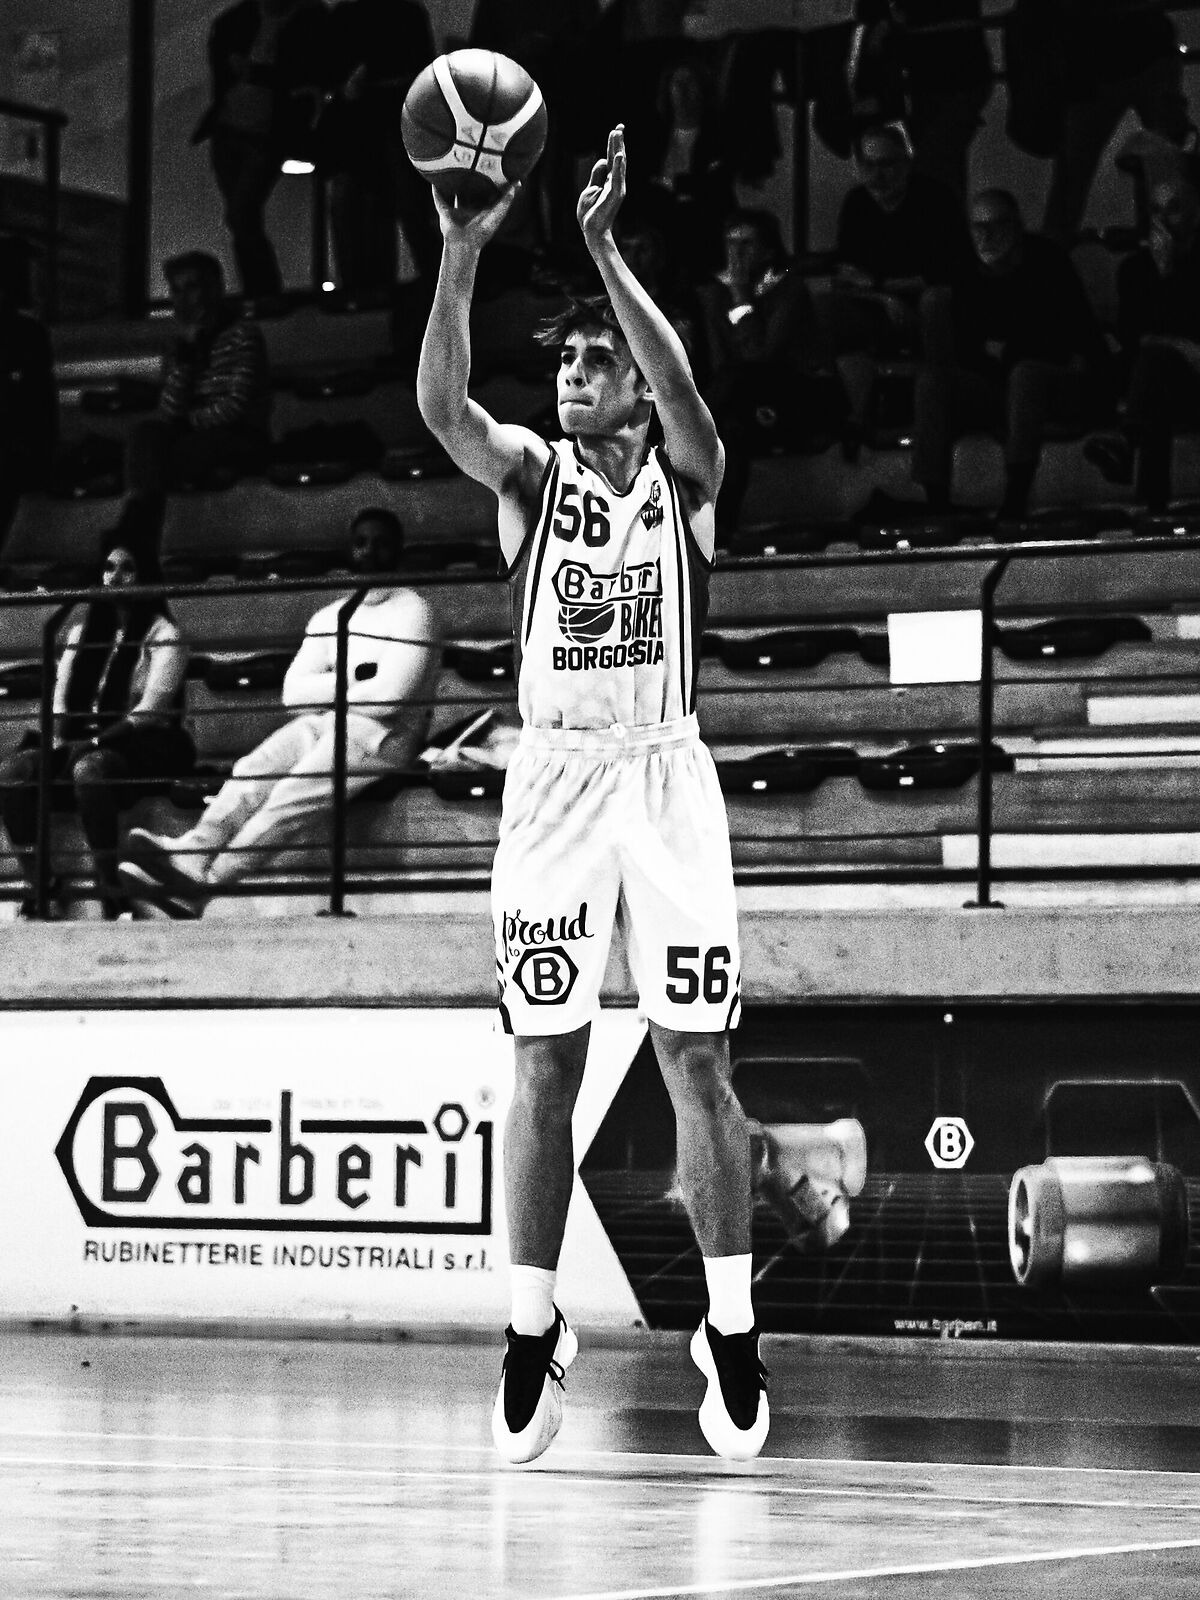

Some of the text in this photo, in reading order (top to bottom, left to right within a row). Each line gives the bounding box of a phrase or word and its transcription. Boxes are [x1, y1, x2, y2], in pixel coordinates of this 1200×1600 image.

[553, 482, 611, 547] 56
[532, 956, 563, 996] B
[665, 945, 731, 1004] 56
[102, 1089, 470, 1209] Barberi
[84, 1240, 263, 1266] RUBINETTERIE
[273, 1245, 434, 1270] INDUSTRIALI
